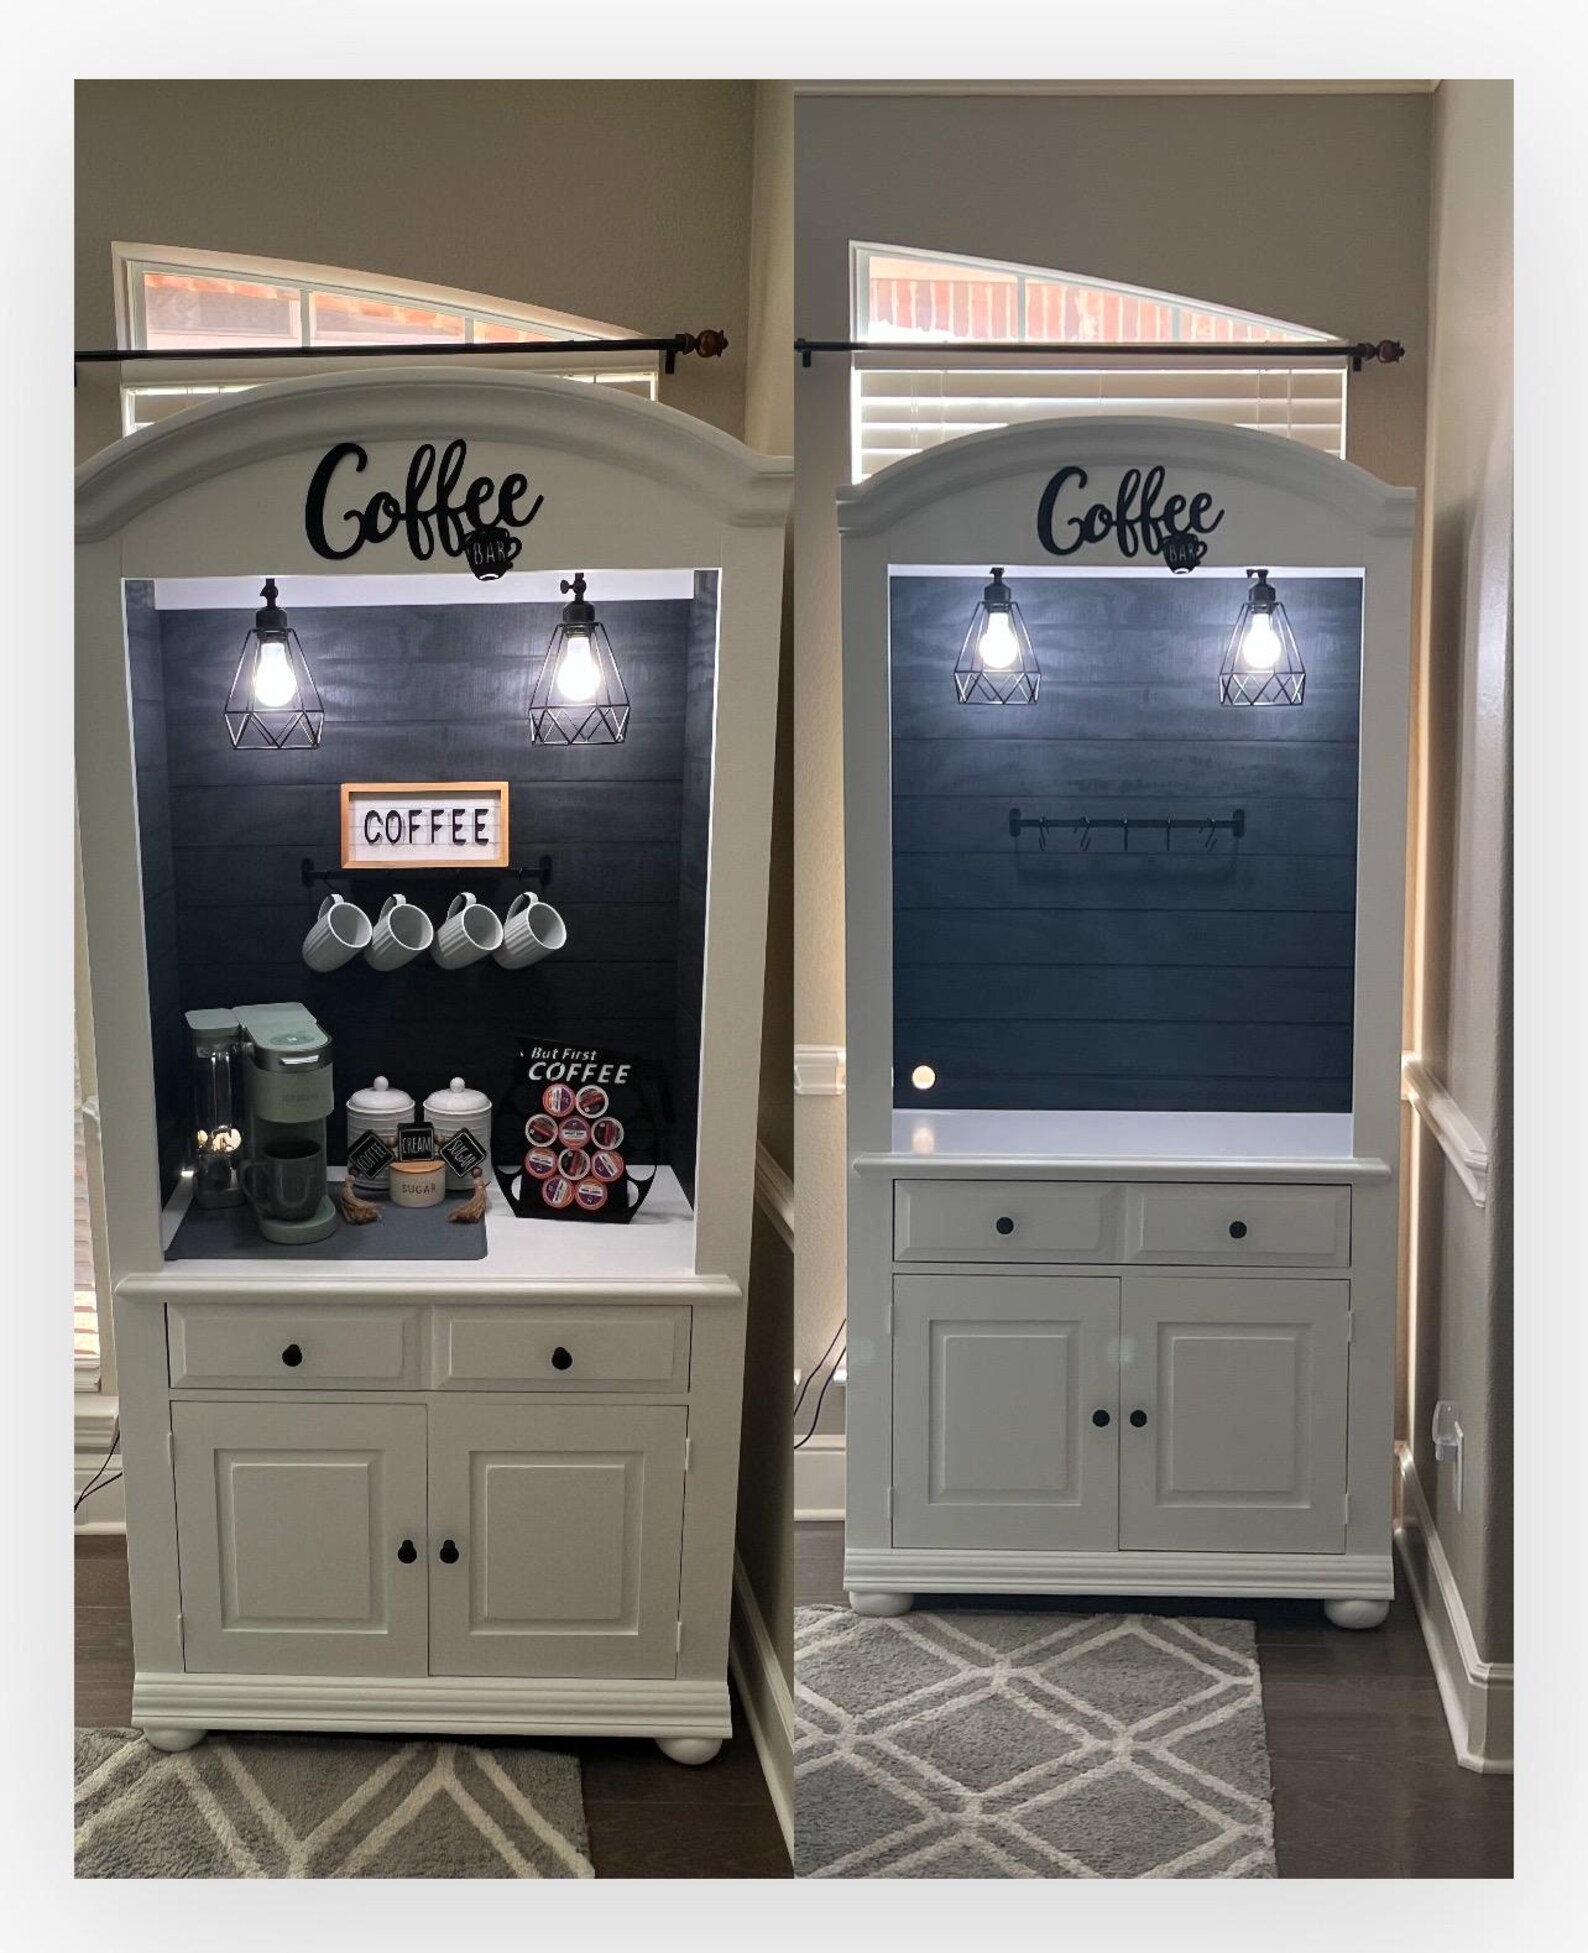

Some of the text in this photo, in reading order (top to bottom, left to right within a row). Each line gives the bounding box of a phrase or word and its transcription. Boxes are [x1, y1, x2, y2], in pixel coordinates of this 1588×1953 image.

[305, 439, 544, 560] Coffee
[1037, 466, 1225, 558] Coffee
[473, 540, 506, 565] BAR
[1169, 543, 1196, 563] BAR
[364, 808, 489, 845] COFFEE
[531, 1047, 597, 1061] But First
[528, 1061, 631, 1084] COFFEE
[402, 1136, 431, 1154] CREAM
[448, 1139, 477, 1171] SUGAR
[401, 1183, 436, 1195] SUGAR
